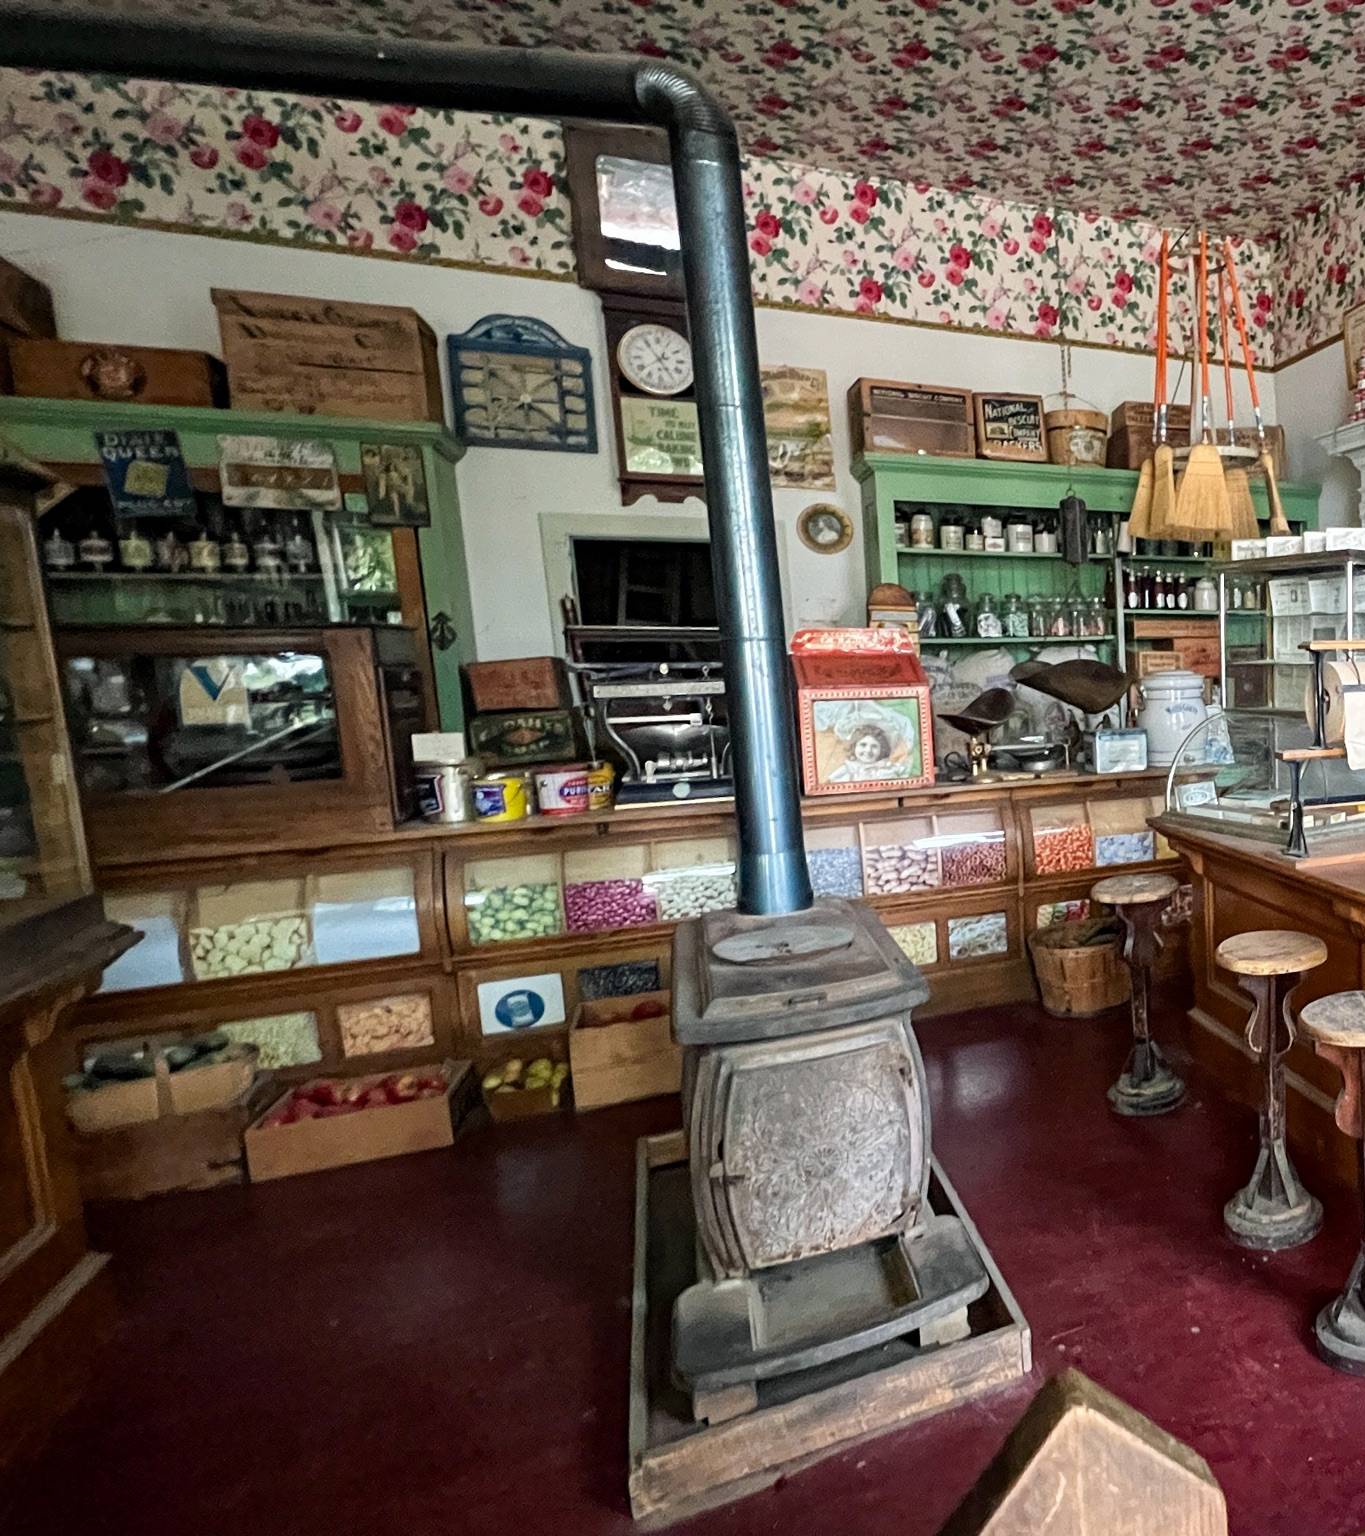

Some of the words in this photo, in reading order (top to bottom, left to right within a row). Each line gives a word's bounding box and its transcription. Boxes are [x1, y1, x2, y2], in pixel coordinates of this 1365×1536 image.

[648, 407, 679, 419] TIME
[984, 402, 1028, 419] NATIONAL
[990, 440, 1043, 452] RACKERS
